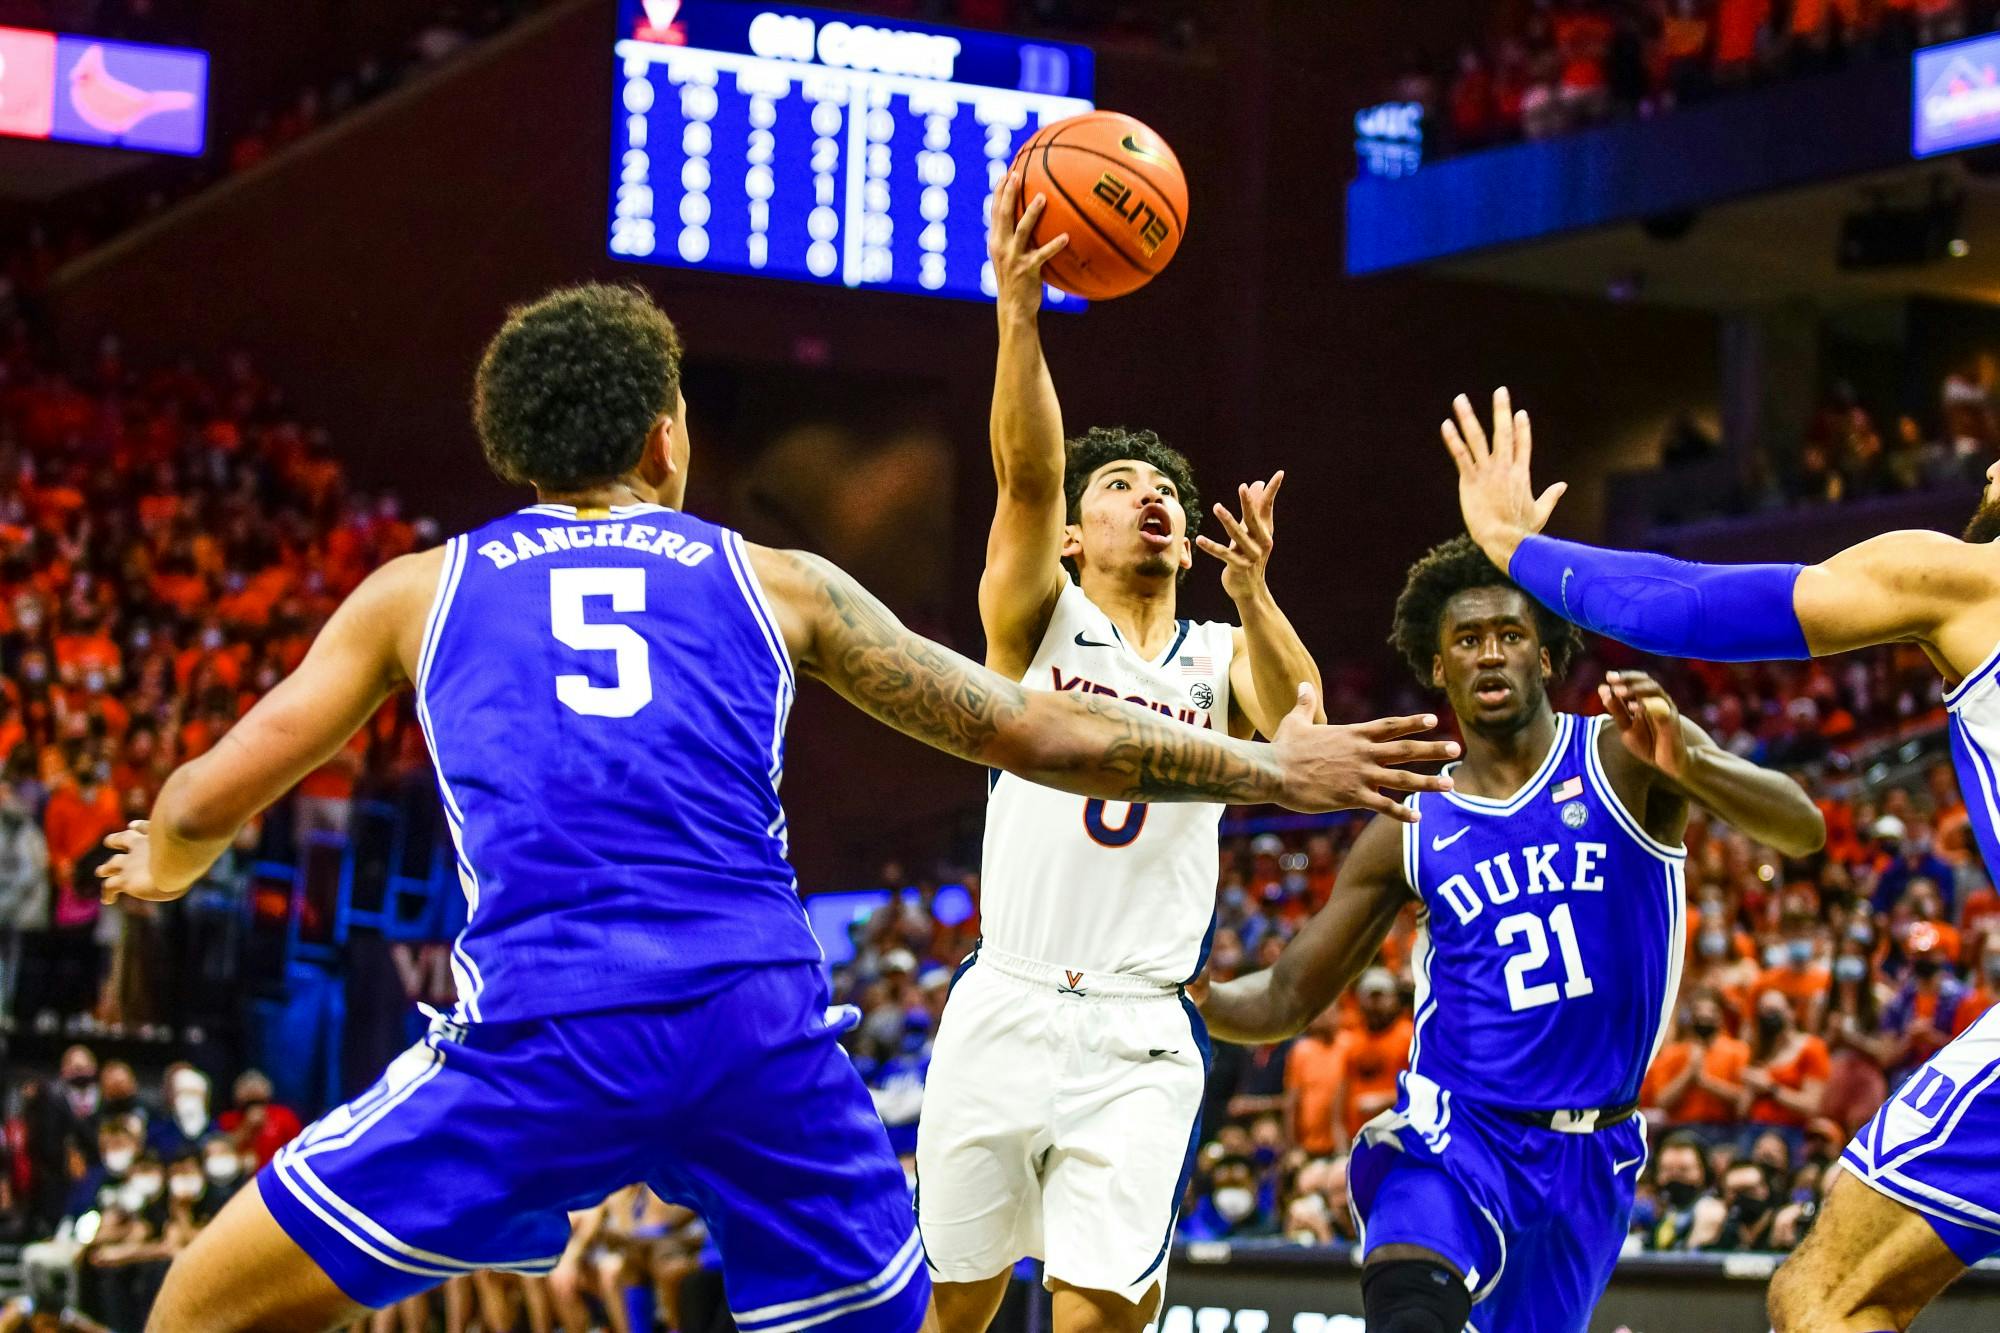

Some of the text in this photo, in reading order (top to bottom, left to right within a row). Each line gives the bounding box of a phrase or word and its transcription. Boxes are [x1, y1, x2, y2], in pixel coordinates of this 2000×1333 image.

[1092, 172, 1169, 251] ELITE
[478, 523, 713, 569] BANCHERO
[550, 567, 652, 718] 5
[1437, 842, 1607, 926] DUKE
[1495, 903, 1593, 1012] 21
